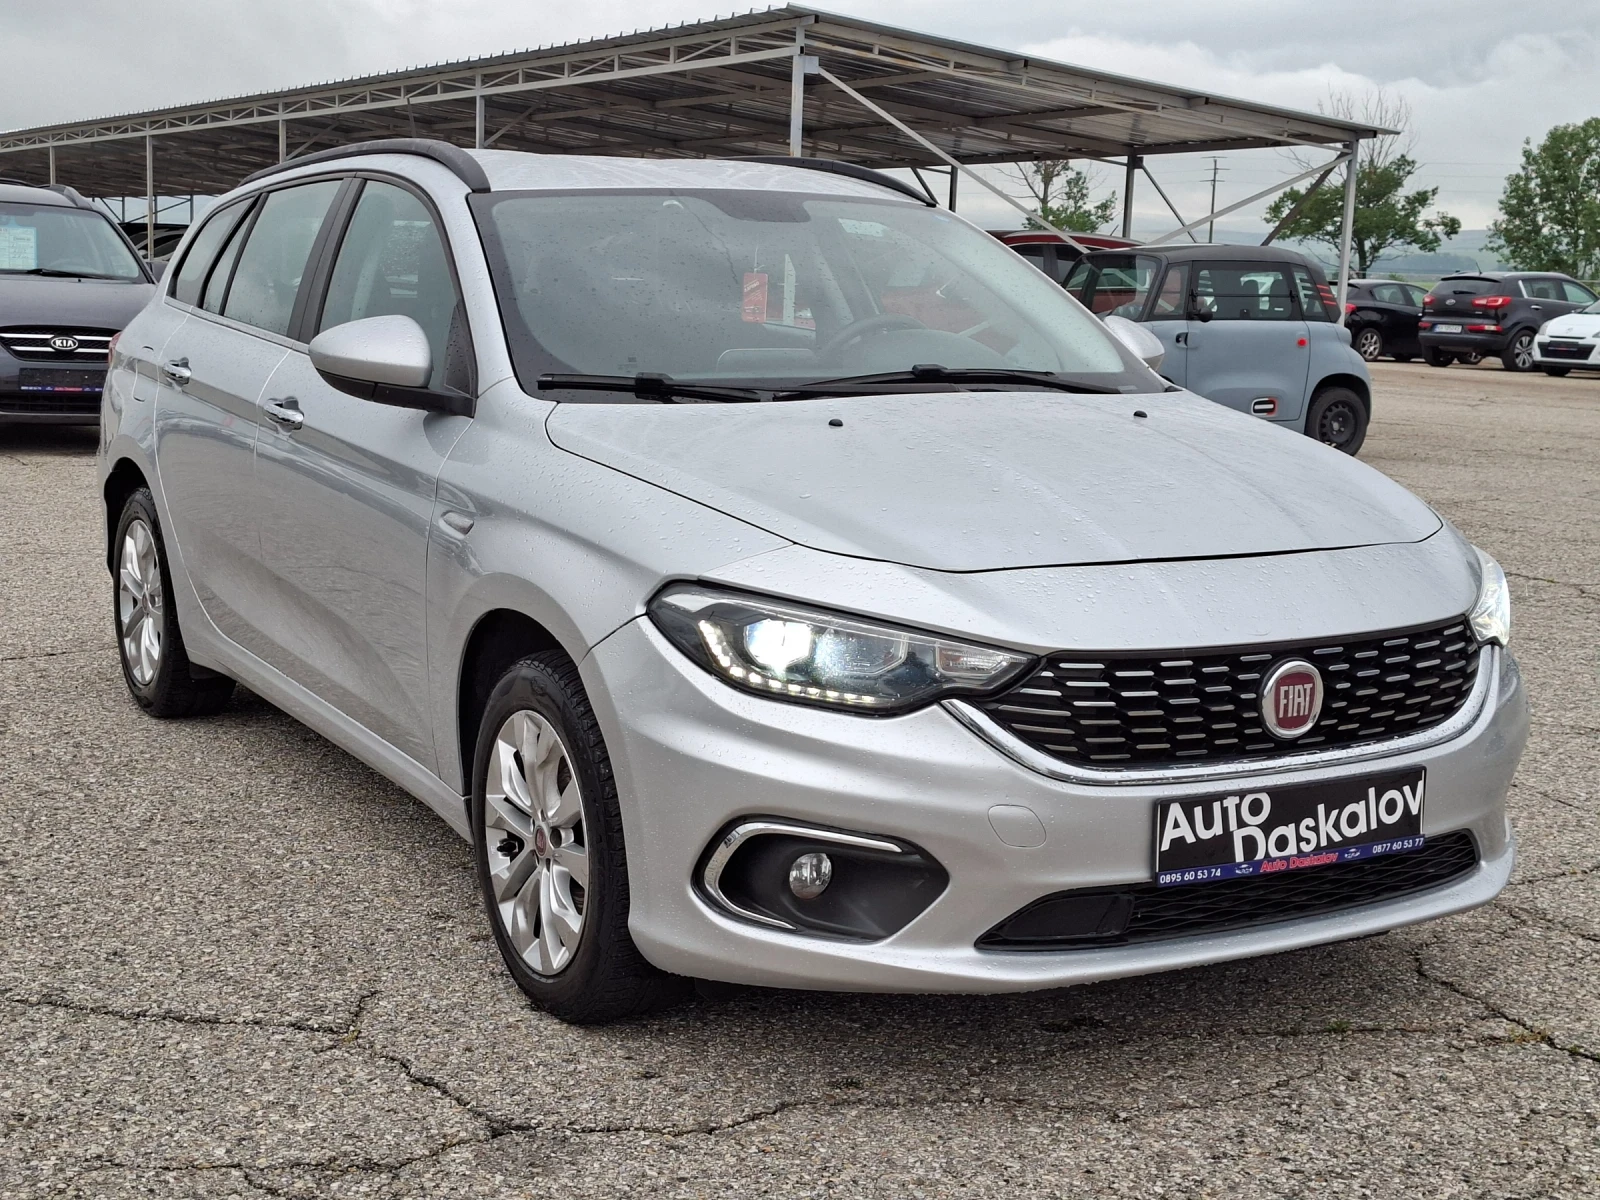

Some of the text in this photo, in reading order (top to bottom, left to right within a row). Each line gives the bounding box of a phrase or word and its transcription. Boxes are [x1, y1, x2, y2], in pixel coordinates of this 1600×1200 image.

[55, 339, 75, 347] KIA
[1279, 683, 1313, 718] FIAT
[1372, 837, 1424, 854] 0877 60 53 77
[1260, 852, 1338, 872] Auto Daskalov
[1160, 867, 1221, 884] 0895 60 53 74
